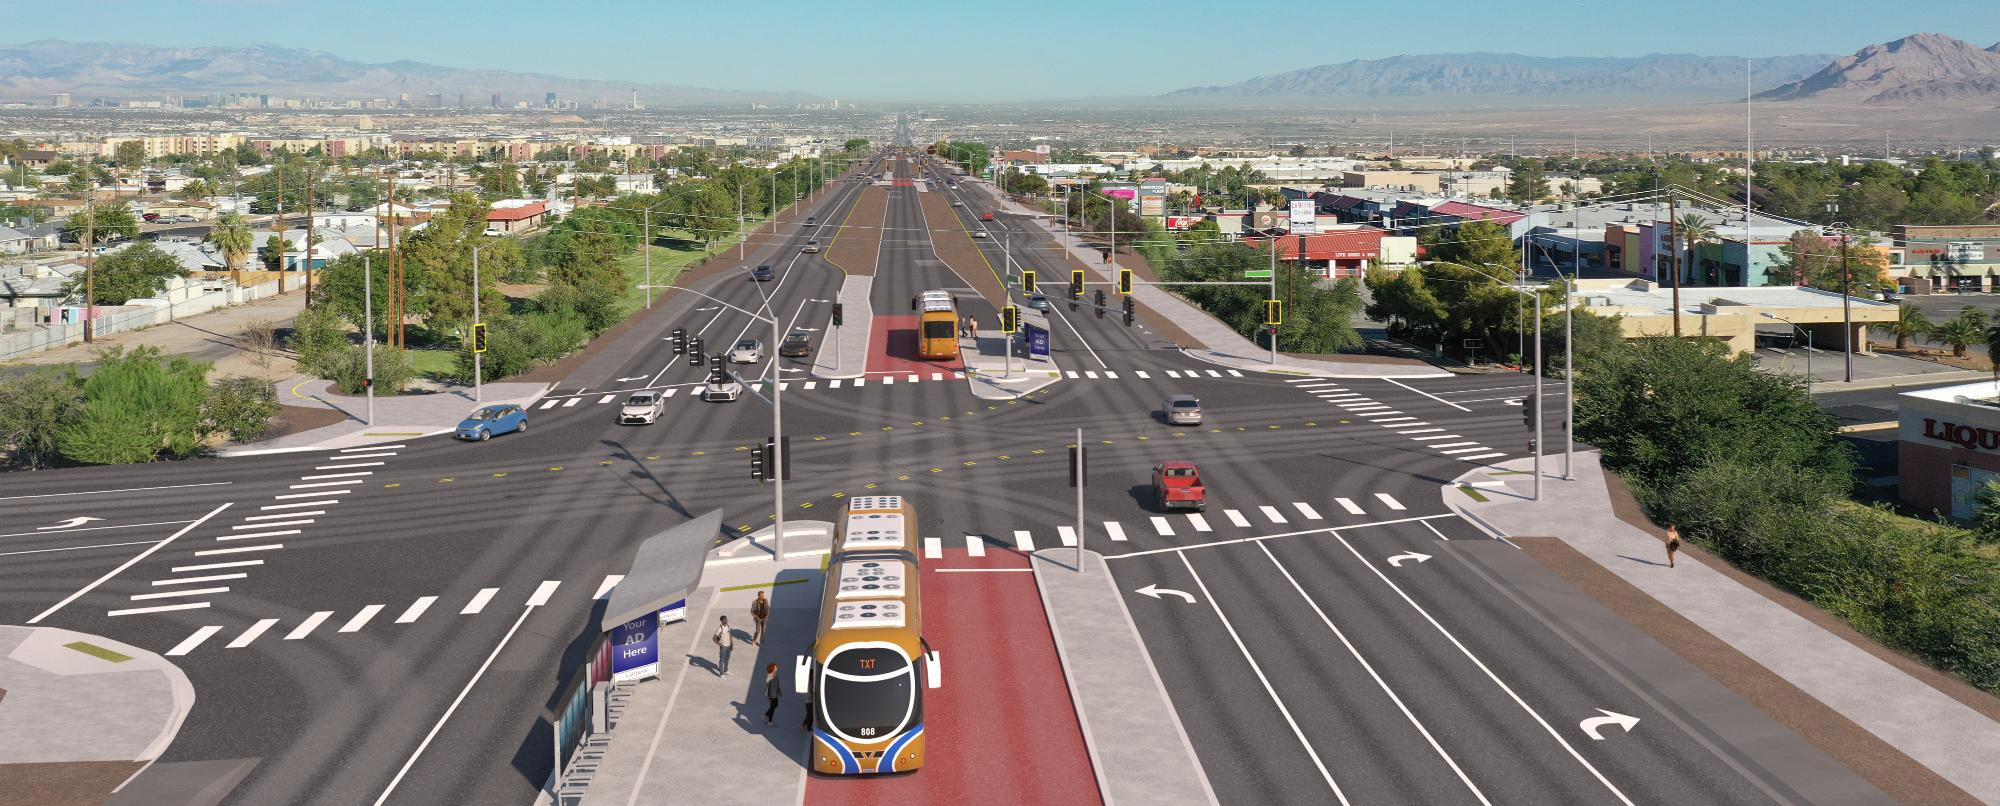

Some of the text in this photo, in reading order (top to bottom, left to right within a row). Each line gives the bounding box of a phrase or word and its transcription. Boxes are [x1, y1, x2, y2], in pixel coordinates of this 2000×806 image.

[623, 620, 646, 631] Your
[625, 632, 645, 646] AD
[623, 646, 647, 659] Here
[860, 659, 876, 669] TXT
[860, 727, 875, 736] 808
